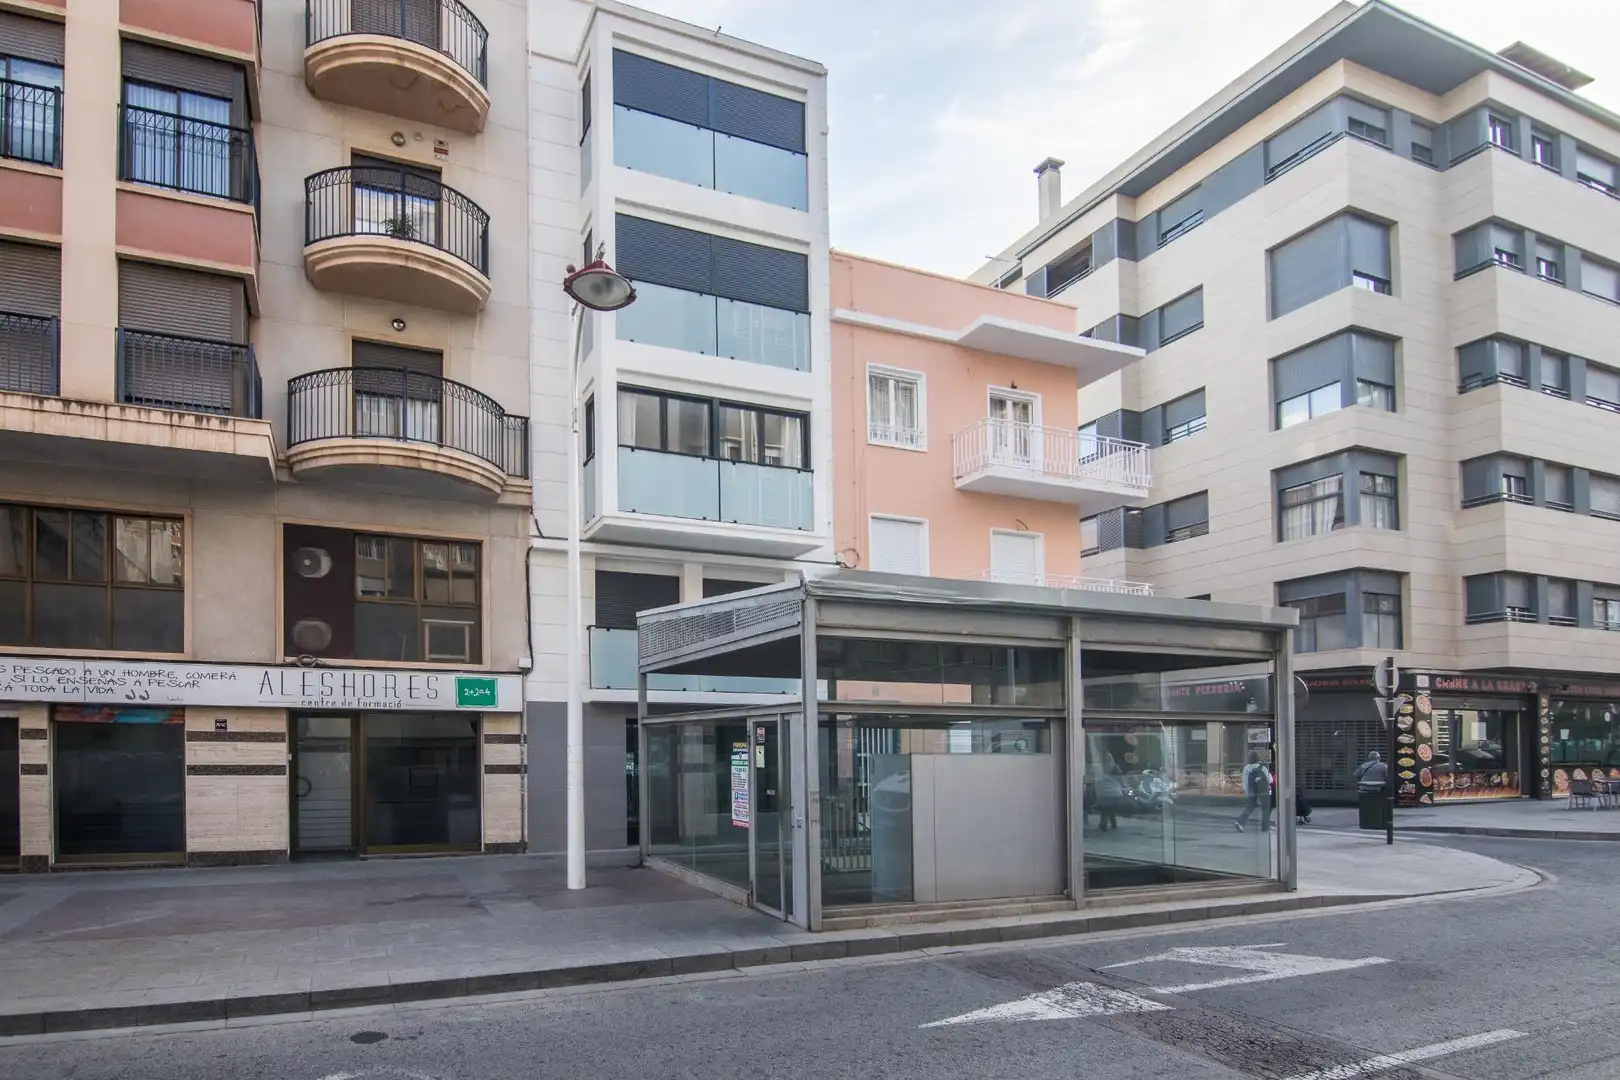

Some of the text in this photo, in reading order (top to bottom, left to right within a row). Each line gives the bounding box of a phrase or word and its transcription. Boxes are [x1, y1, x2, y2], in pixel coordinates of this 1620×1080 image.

[13, 665, 77, 675] PESCADO
[83, 668, 92, 676] A
[99, 669, 116, 677] UN
[185, 671, 237, 681] COMERÁ
[10, 674, 26, 683] SI
[32, 675, 49, 684] LO
[133, 679, 142, 687] A
[148, 679, 201, 688] PESCAR
[258, 669, 439, 700] ALESHORES
[20, 684, 57, 693] TODA
[63, 685, 80, 694] LA
[464, 687, 491, 697] 2+2=4
[1195, 683, 1242, 696] PIZZERIA
[301, 697, 337, 708] centre
[341, 698, 353, 707] de
